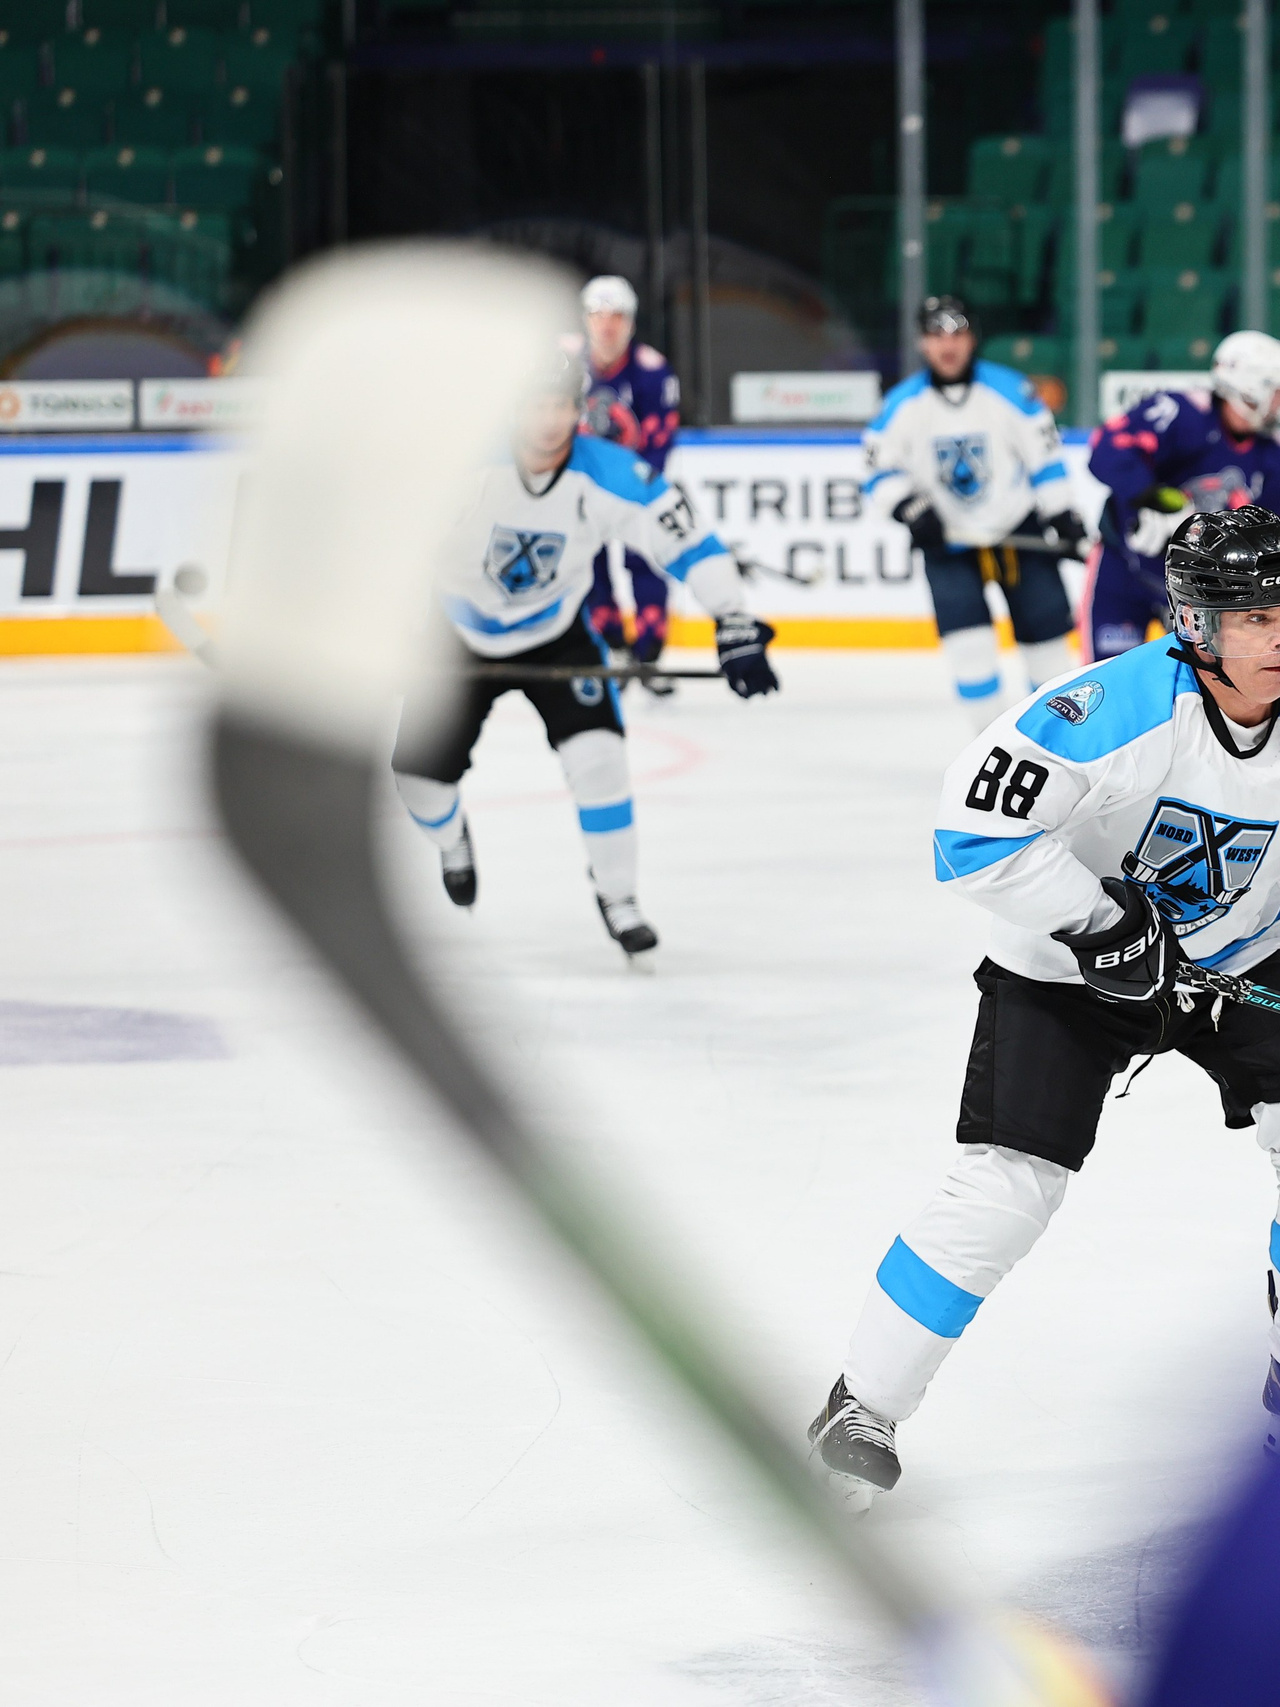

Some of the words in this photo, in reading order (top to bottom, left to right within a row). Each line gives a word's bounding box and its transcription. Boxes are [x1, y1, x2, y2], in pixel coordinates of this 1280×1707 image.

[692, 479, 864, 520] TRIB
[786, 540, 913, 583] CLU
[964, 745, 1050, 821] 88
[1155, 823, 1194, 844] NORD
[1225, 846, 1263, 863] WEST
